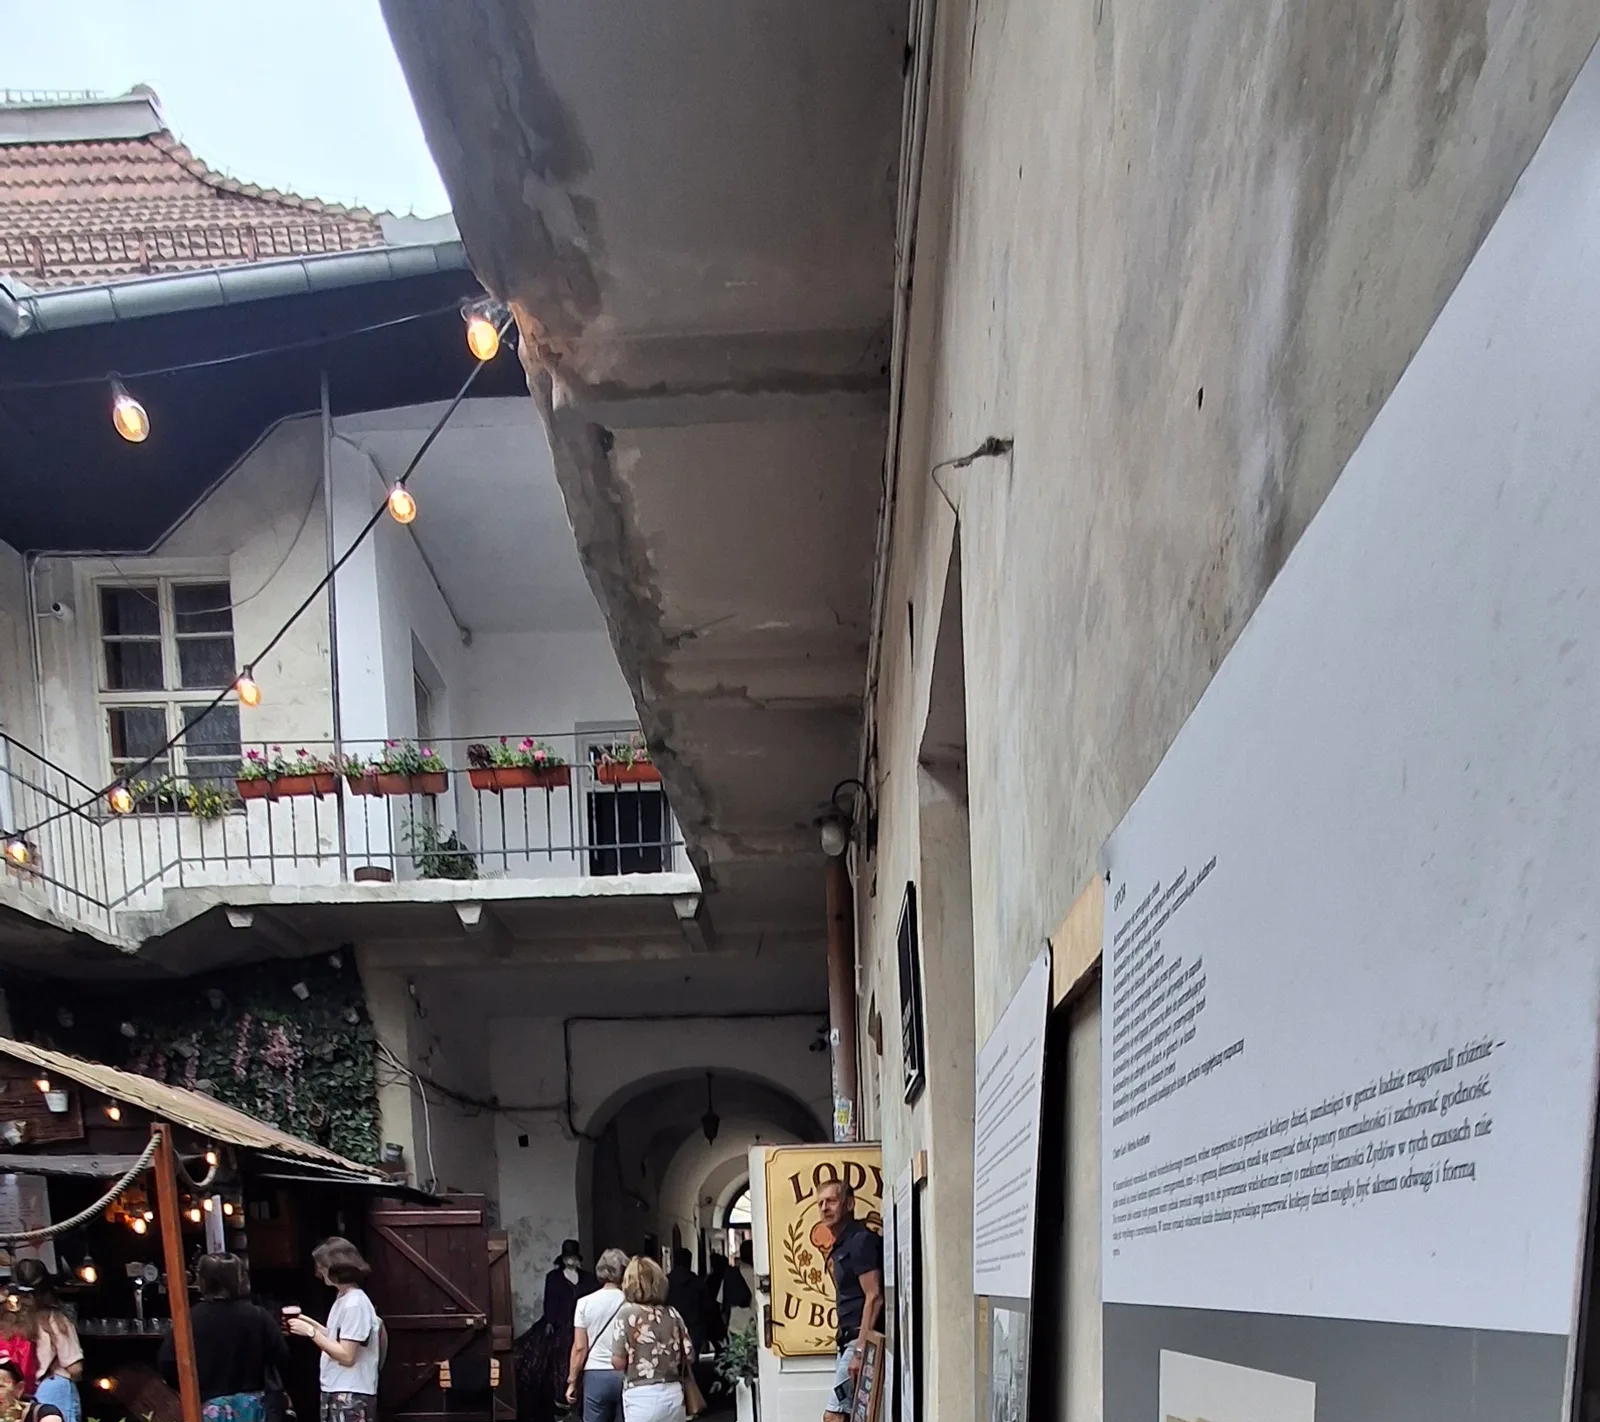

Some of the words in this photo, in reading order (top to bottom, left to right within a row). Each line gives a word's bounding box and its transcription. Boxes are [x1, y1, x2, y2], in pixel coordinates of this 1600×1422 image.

[1407, 1048, 1453, 1088] reagowali
[1457, 1035, 1493, 1067] różnie
[1393, 1089, 1439, 1124] zachować
[1366, 1140, 1394, 1169] Żydów
[1398, 1141, 1406, 1156] w
[1431, 1117, 1471, 1148] czasach
[1475, 1113, 1492, 1137] nie
[788, 1161, 883, 1204] LODY
[1400, 1163, 1433, 1192] odwagi
[1442, 1159, 1476, 1182] formą
[784, 1292, 801, 1320] U
